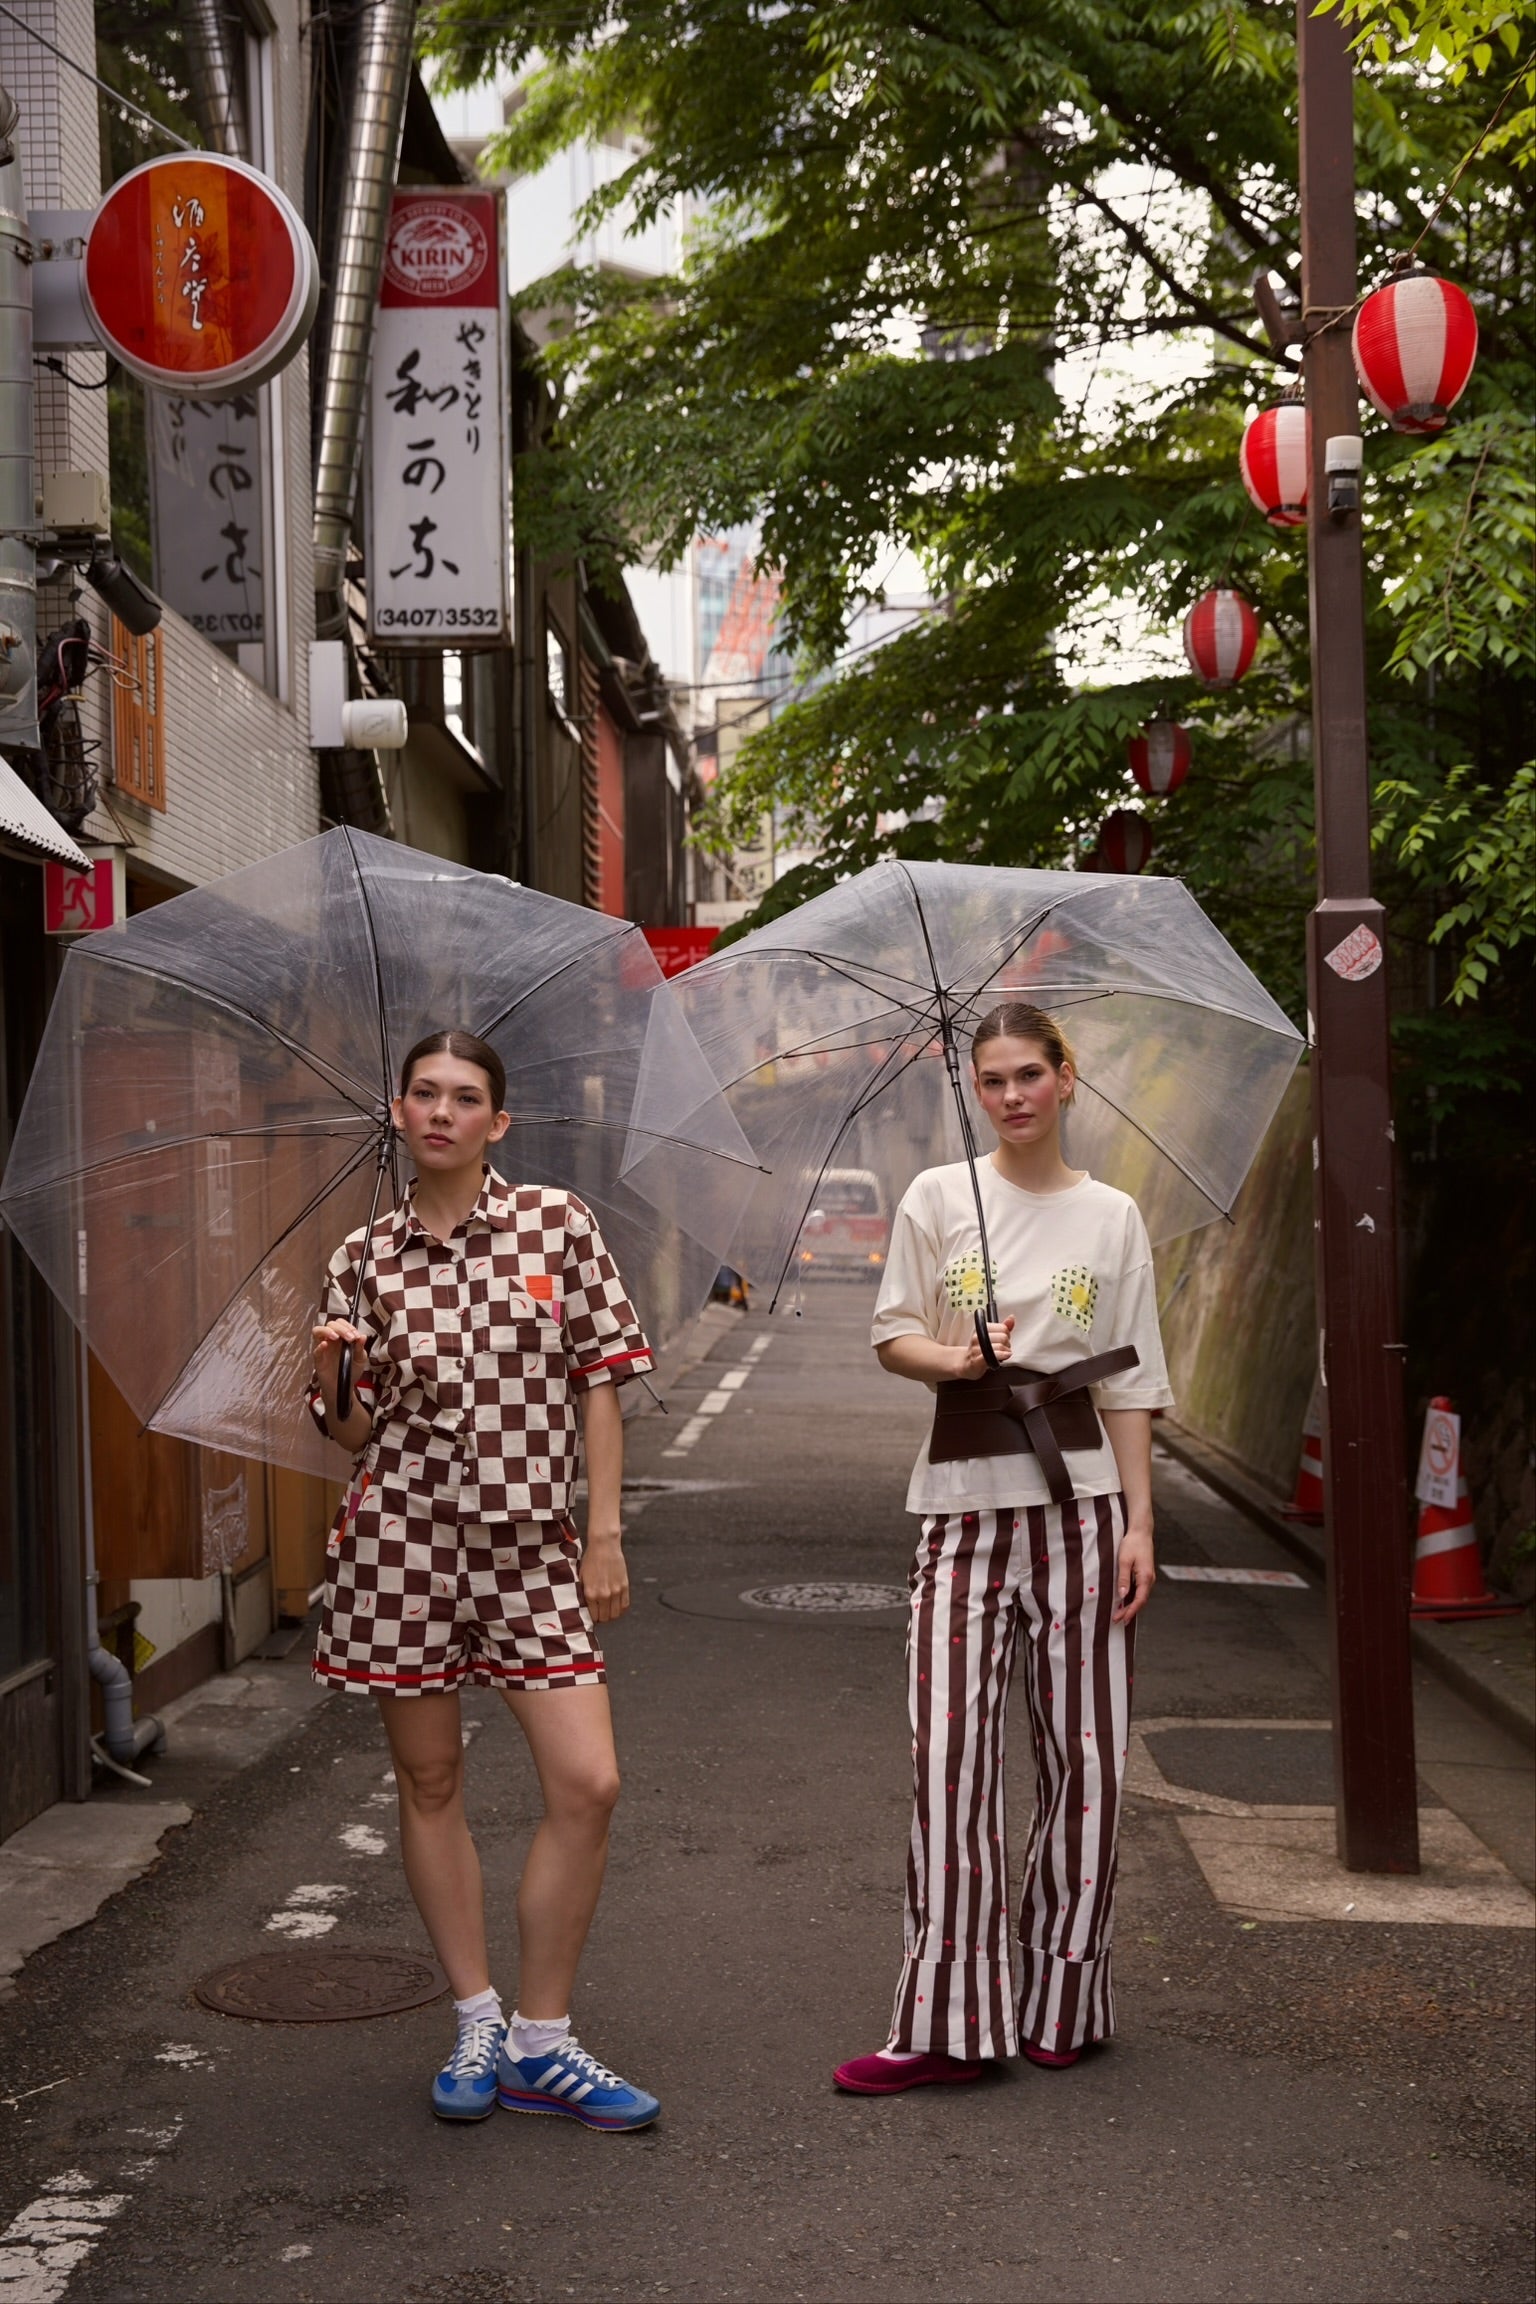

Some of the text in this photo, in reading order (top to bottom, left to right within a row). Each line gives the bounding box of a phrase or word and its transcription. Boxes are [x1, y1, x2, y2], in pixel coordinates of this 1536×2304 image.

[401, 248, 465, 267] KIRIN
[456, 321, 486, 455] やきとり
[377, 607, 498, 627] (3407)3532
